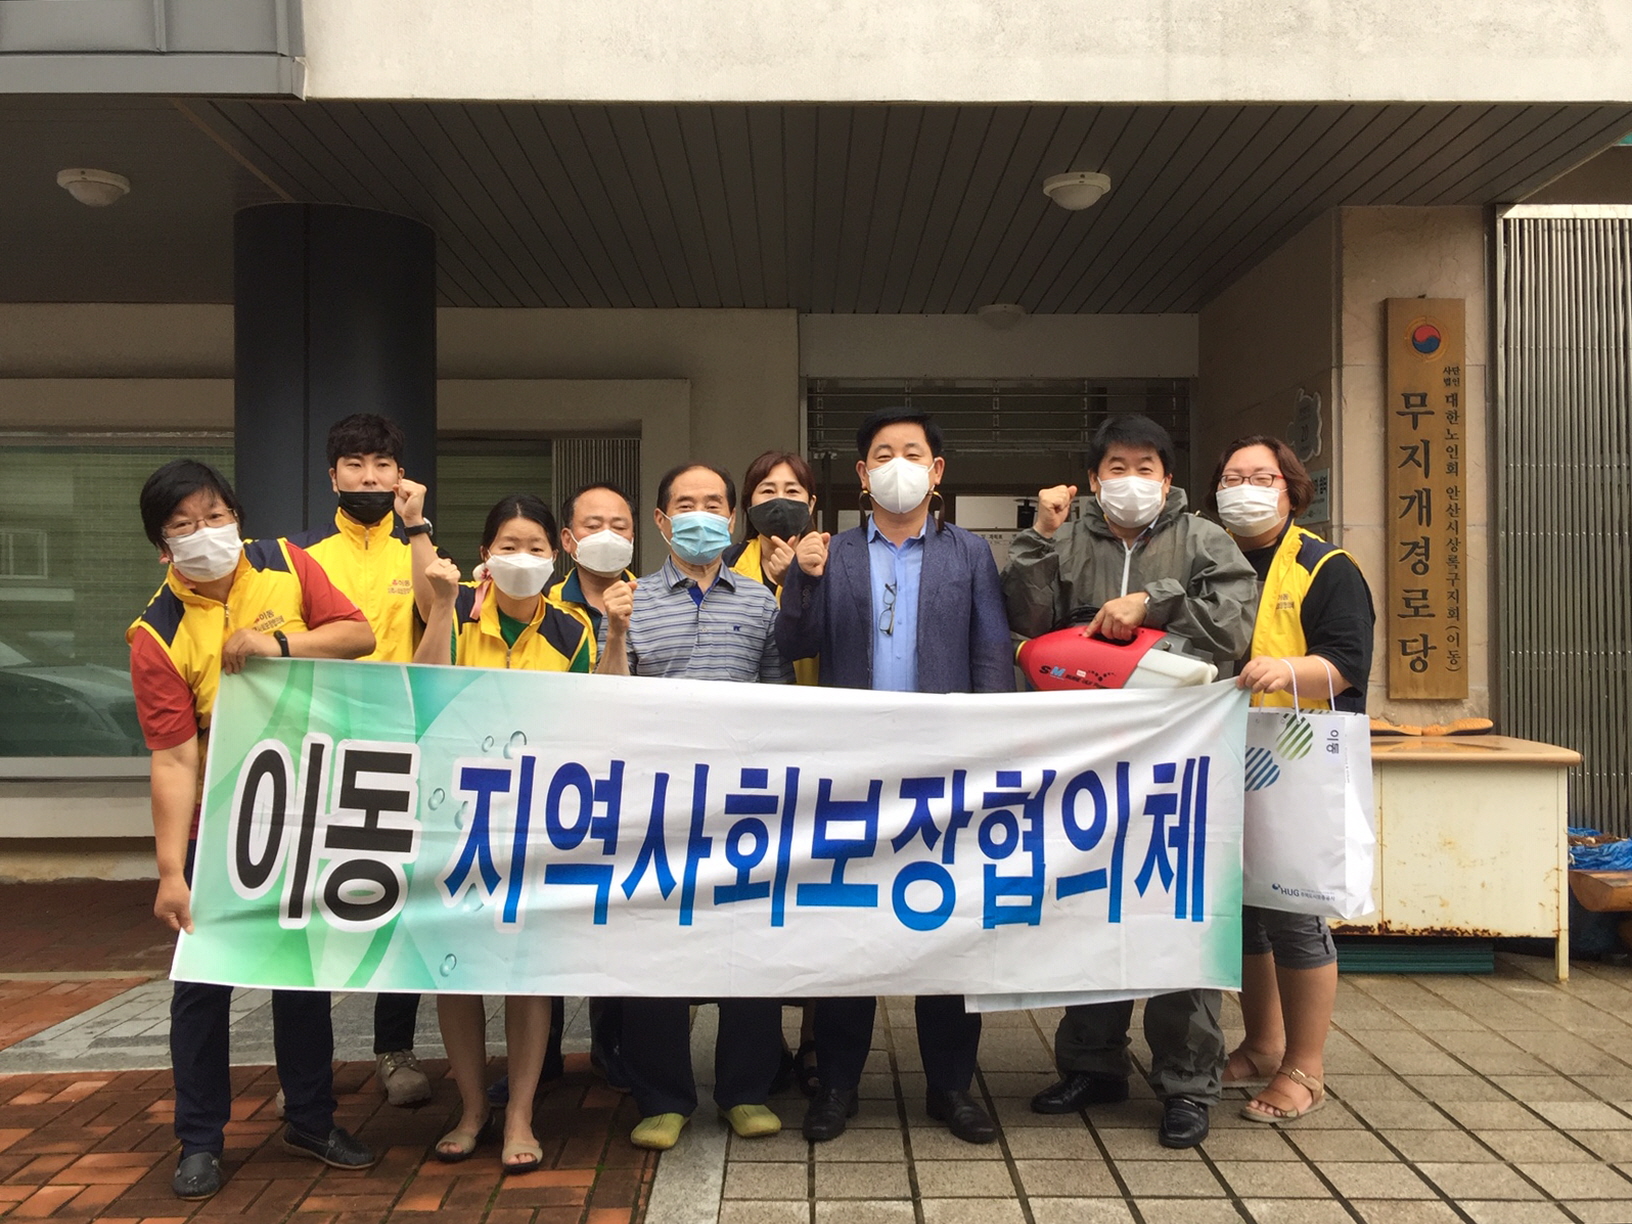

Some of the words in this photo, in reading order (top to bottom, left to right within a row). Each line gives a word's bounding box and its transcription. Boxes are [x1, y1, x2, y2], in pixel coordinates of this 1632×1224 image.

[1443, 366, 1460, 376] 사단
[1445, 392, 1461, 477] 대한노인회
[1395, 391, 1437, 674] 무지개경로당
[258, 609, 275, 621] 이동
[1039, 665, 1066, 677] SM
[235, 742, 415, 922] 이동
[443, 755, 1211, 932] 지역사회보장협의체
[1280, 887, 1300, 898] HUG
